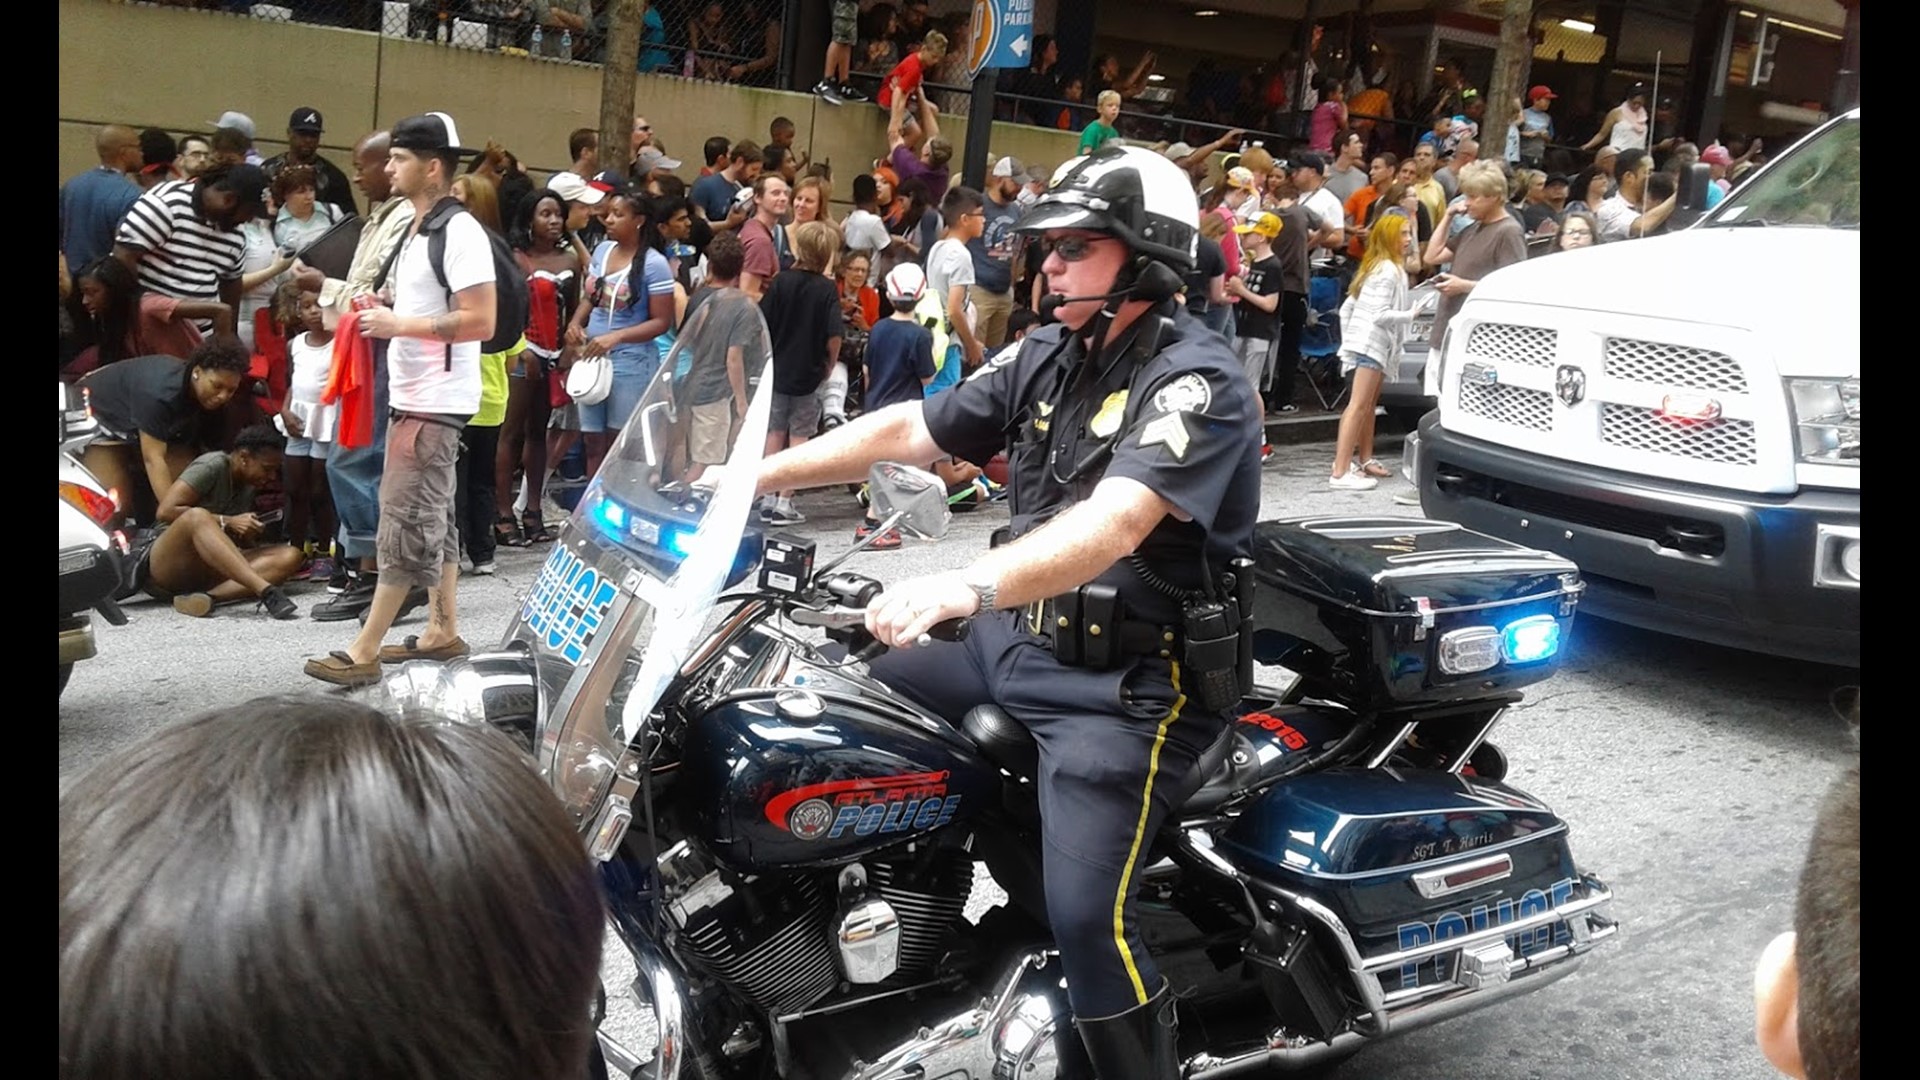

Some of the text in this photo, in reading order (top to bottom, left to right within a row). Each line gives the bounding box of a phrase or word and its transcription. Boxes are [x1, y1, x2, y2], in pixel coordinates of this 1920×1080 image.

[833, 783, 947, 806] ATLANTA
[827, 794, 962, 838] POLICE
[1460, 831, 1494, 849] Harris
